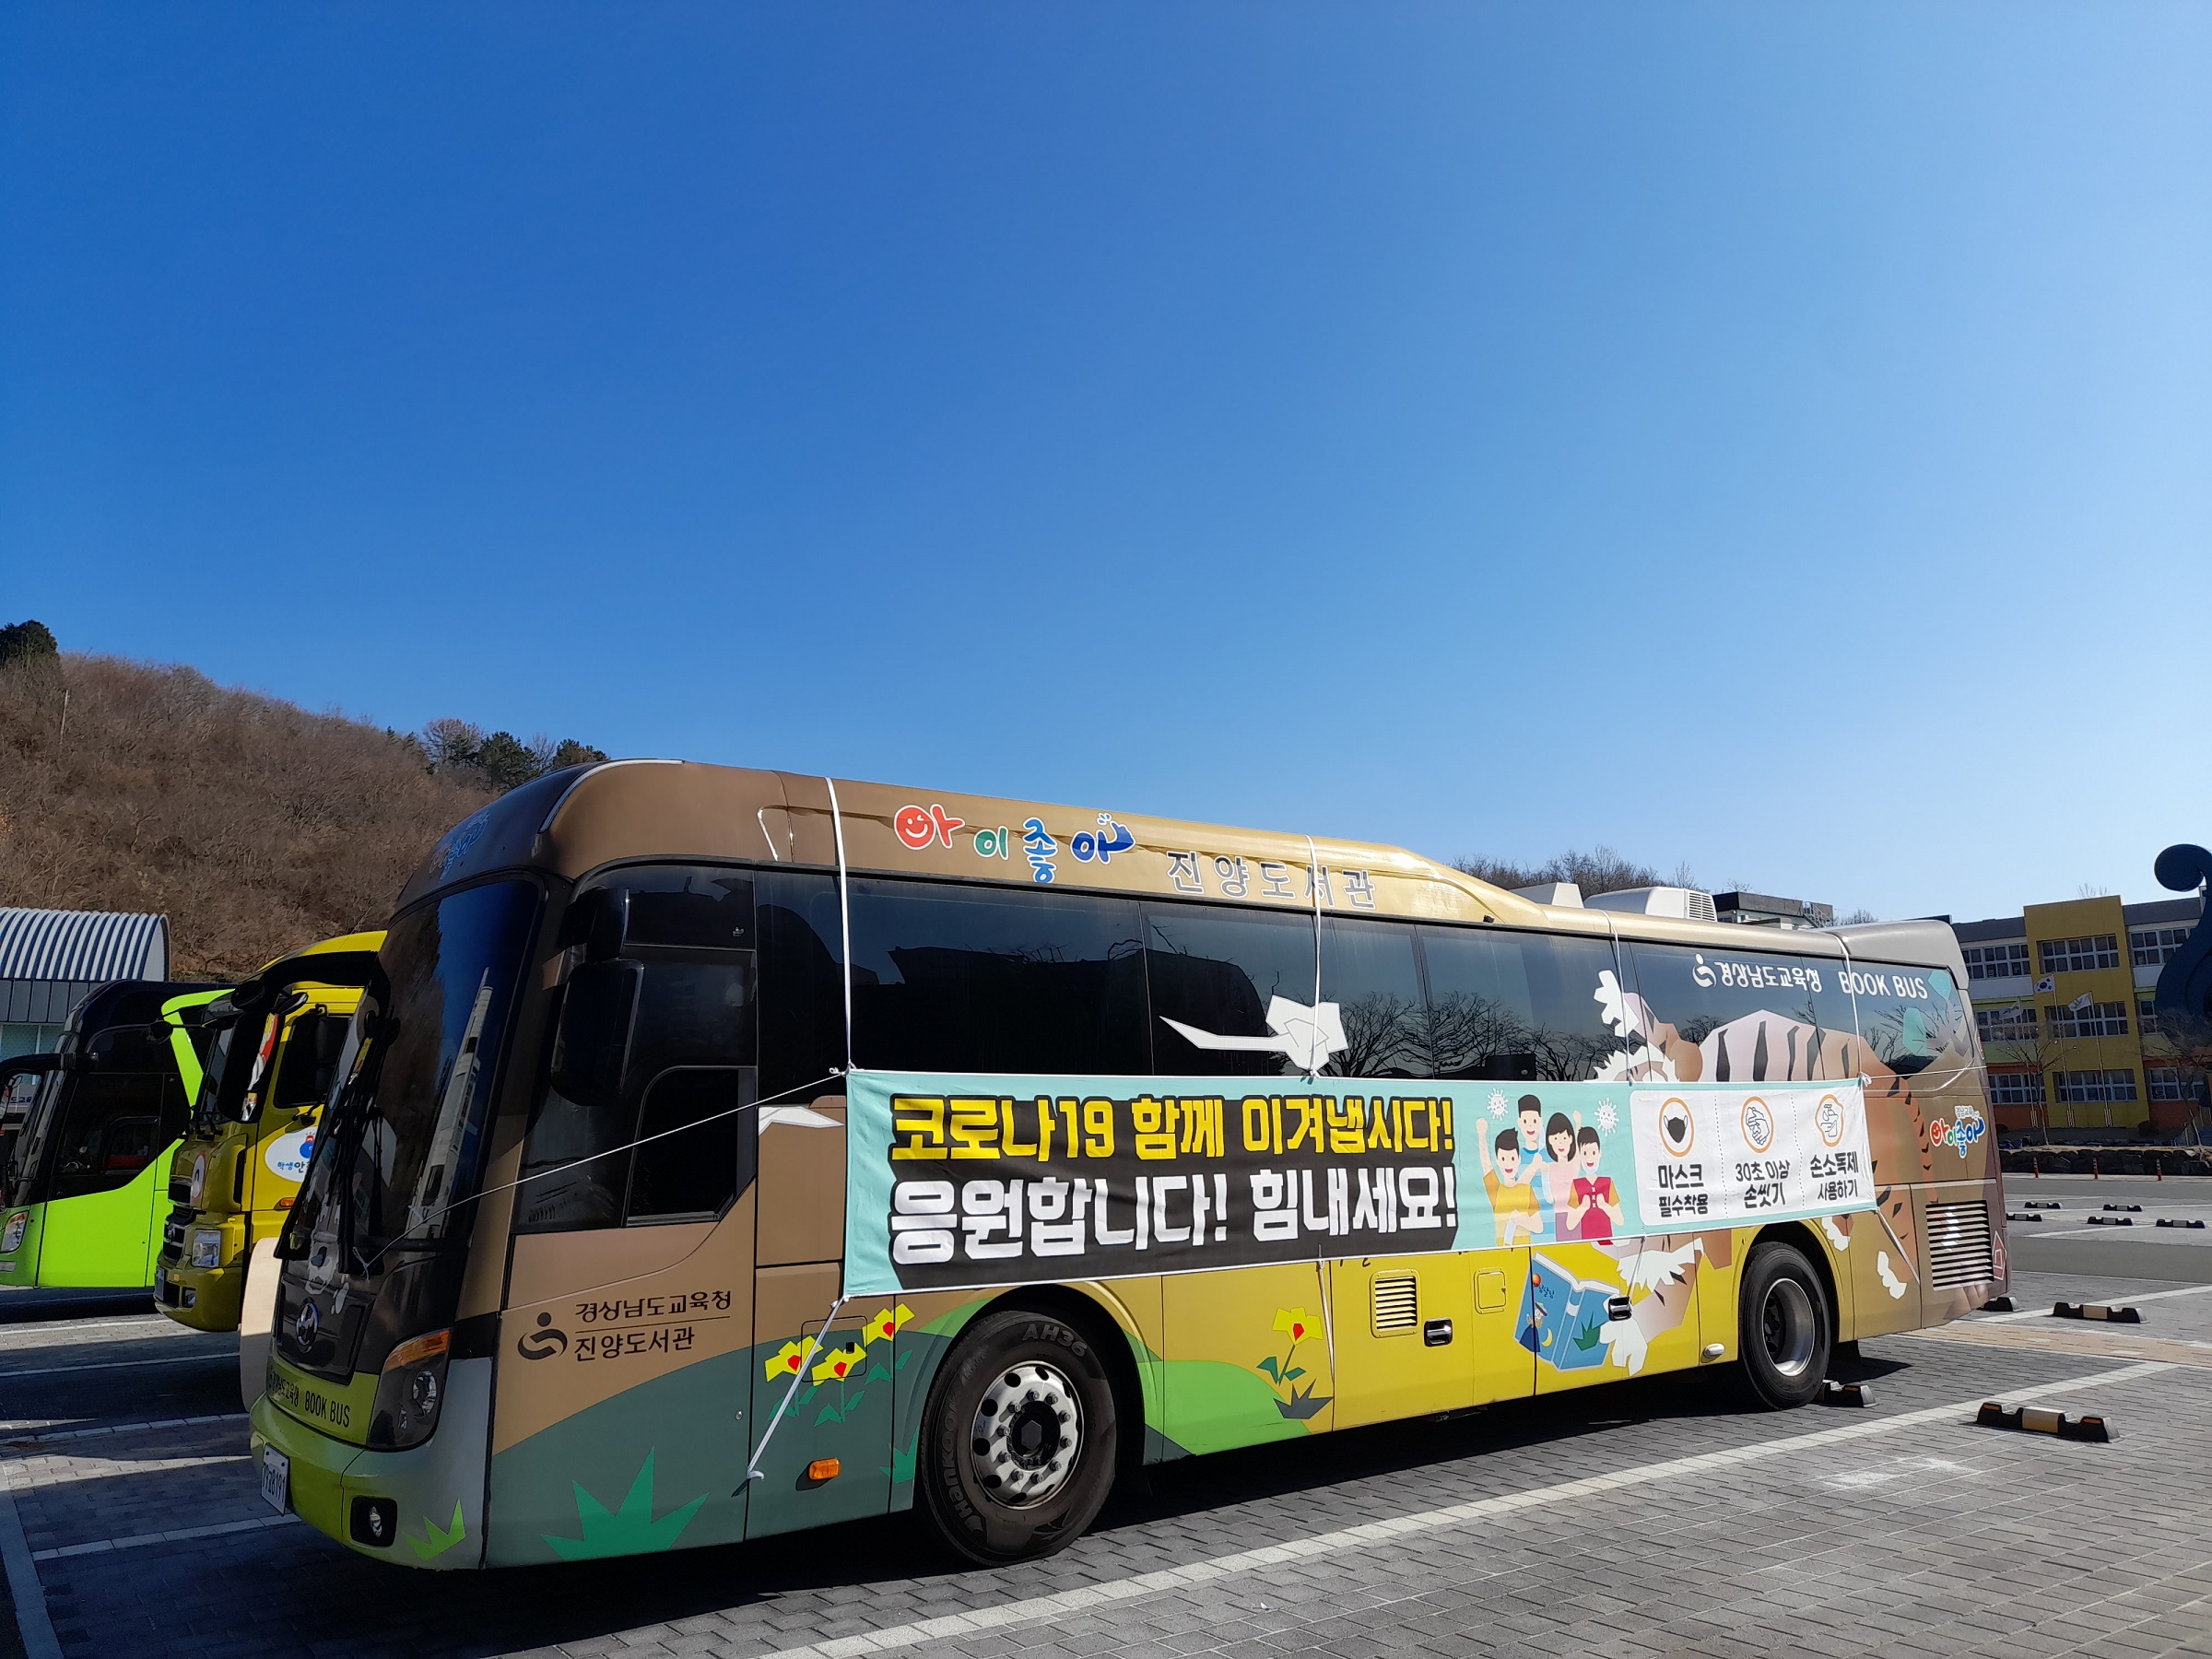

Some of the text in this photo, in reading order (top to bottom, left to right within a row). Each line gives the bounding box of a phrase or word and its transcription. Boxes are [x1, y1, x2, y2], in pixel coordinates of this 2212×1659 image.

[1166, 850, 1376, 910] 진양도서관
[1714, 961, 1823, 993] 경상남도교육청
[1838, 971, 1929, 999] BOOK BUS
[890, 1096, 1454, 1161] 코로나19 함께 이겨냅시다!
[1658, 1163, 1704, 1190] 마스크
[1735, 1159, 1791, 1182] 30초 이상
[1809, 1151, 1859, 1178] 손소독제
[1744, 1182, 1786, 1208] 손씻기
[1818, 1179, 1858, 1201] 사용하기
[890, 1166, 1456, 1265] 응원합니다! 힘내세요!
[1659, 1194, 1709, 1218] 필수착용
[575, 1290, 731, 1323] 경상남도교육청
[574, 1326, 695, 1362] 진양도서관
[305, 1390, 350, 1429] BOOK BUS
